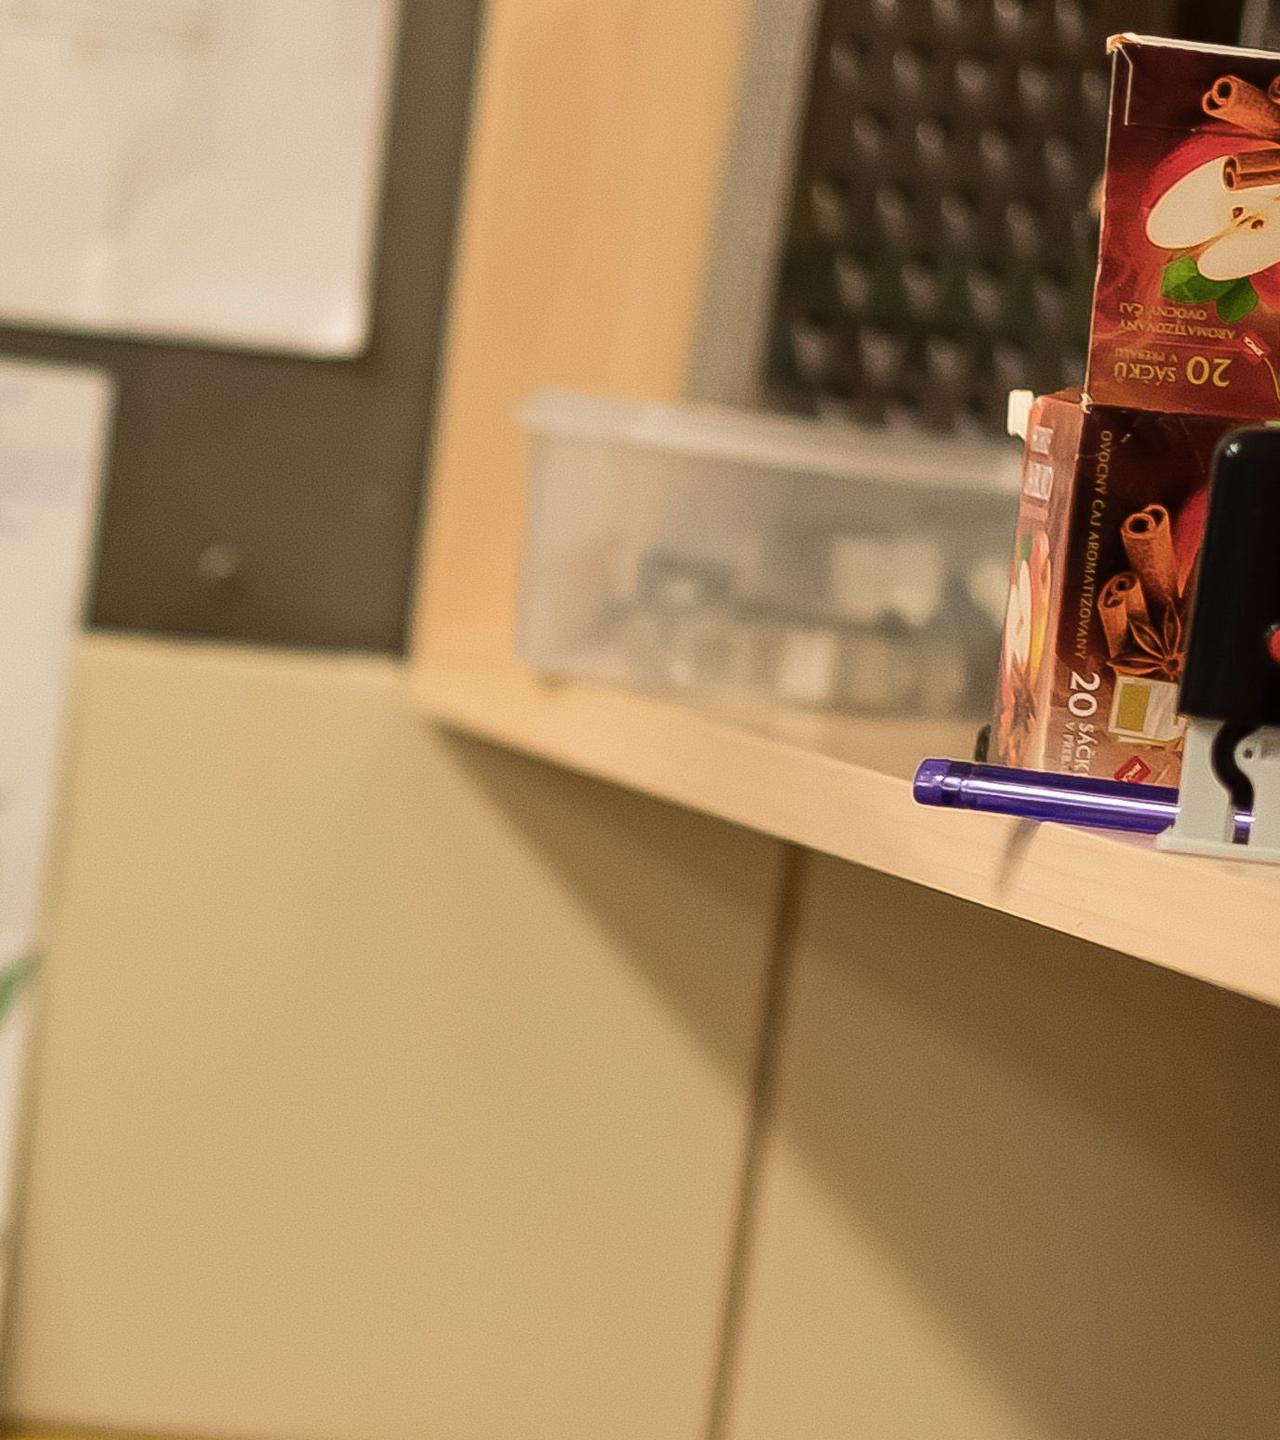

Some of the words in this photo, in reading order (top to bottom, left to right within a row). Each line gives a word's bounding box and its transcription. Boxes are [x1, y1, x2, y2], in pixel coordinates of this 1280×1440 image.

[1186, 355, 1233, 388] 20
[1068, 670, 1101, 717] 20
[1073, 722, 1099, 774] SÁČK
